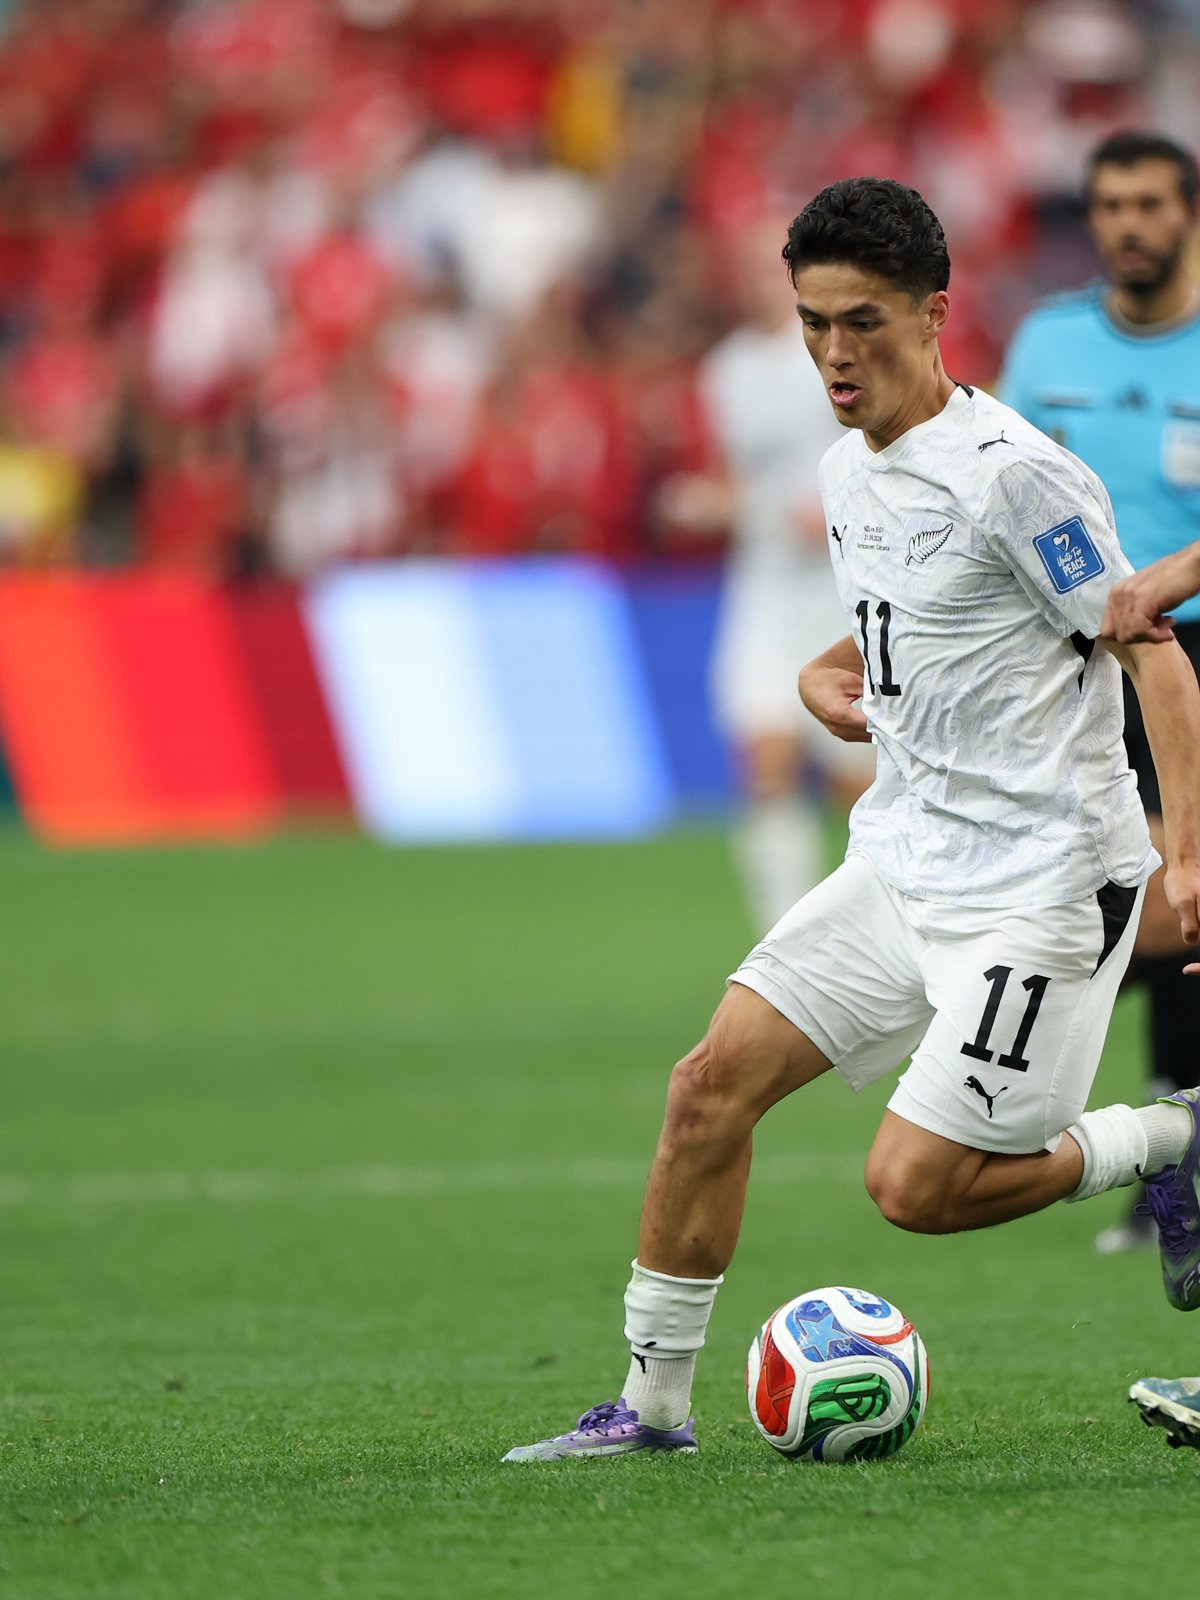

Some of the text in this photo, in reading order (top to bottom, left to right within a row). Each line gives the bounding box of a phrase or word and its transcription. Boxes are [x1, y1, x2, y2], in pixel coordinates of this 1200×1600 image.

[1062, 556, 1087, 577] PEACE
[855, 600, 901, 696] 11
[960, 965, 1053, 1072] 11
